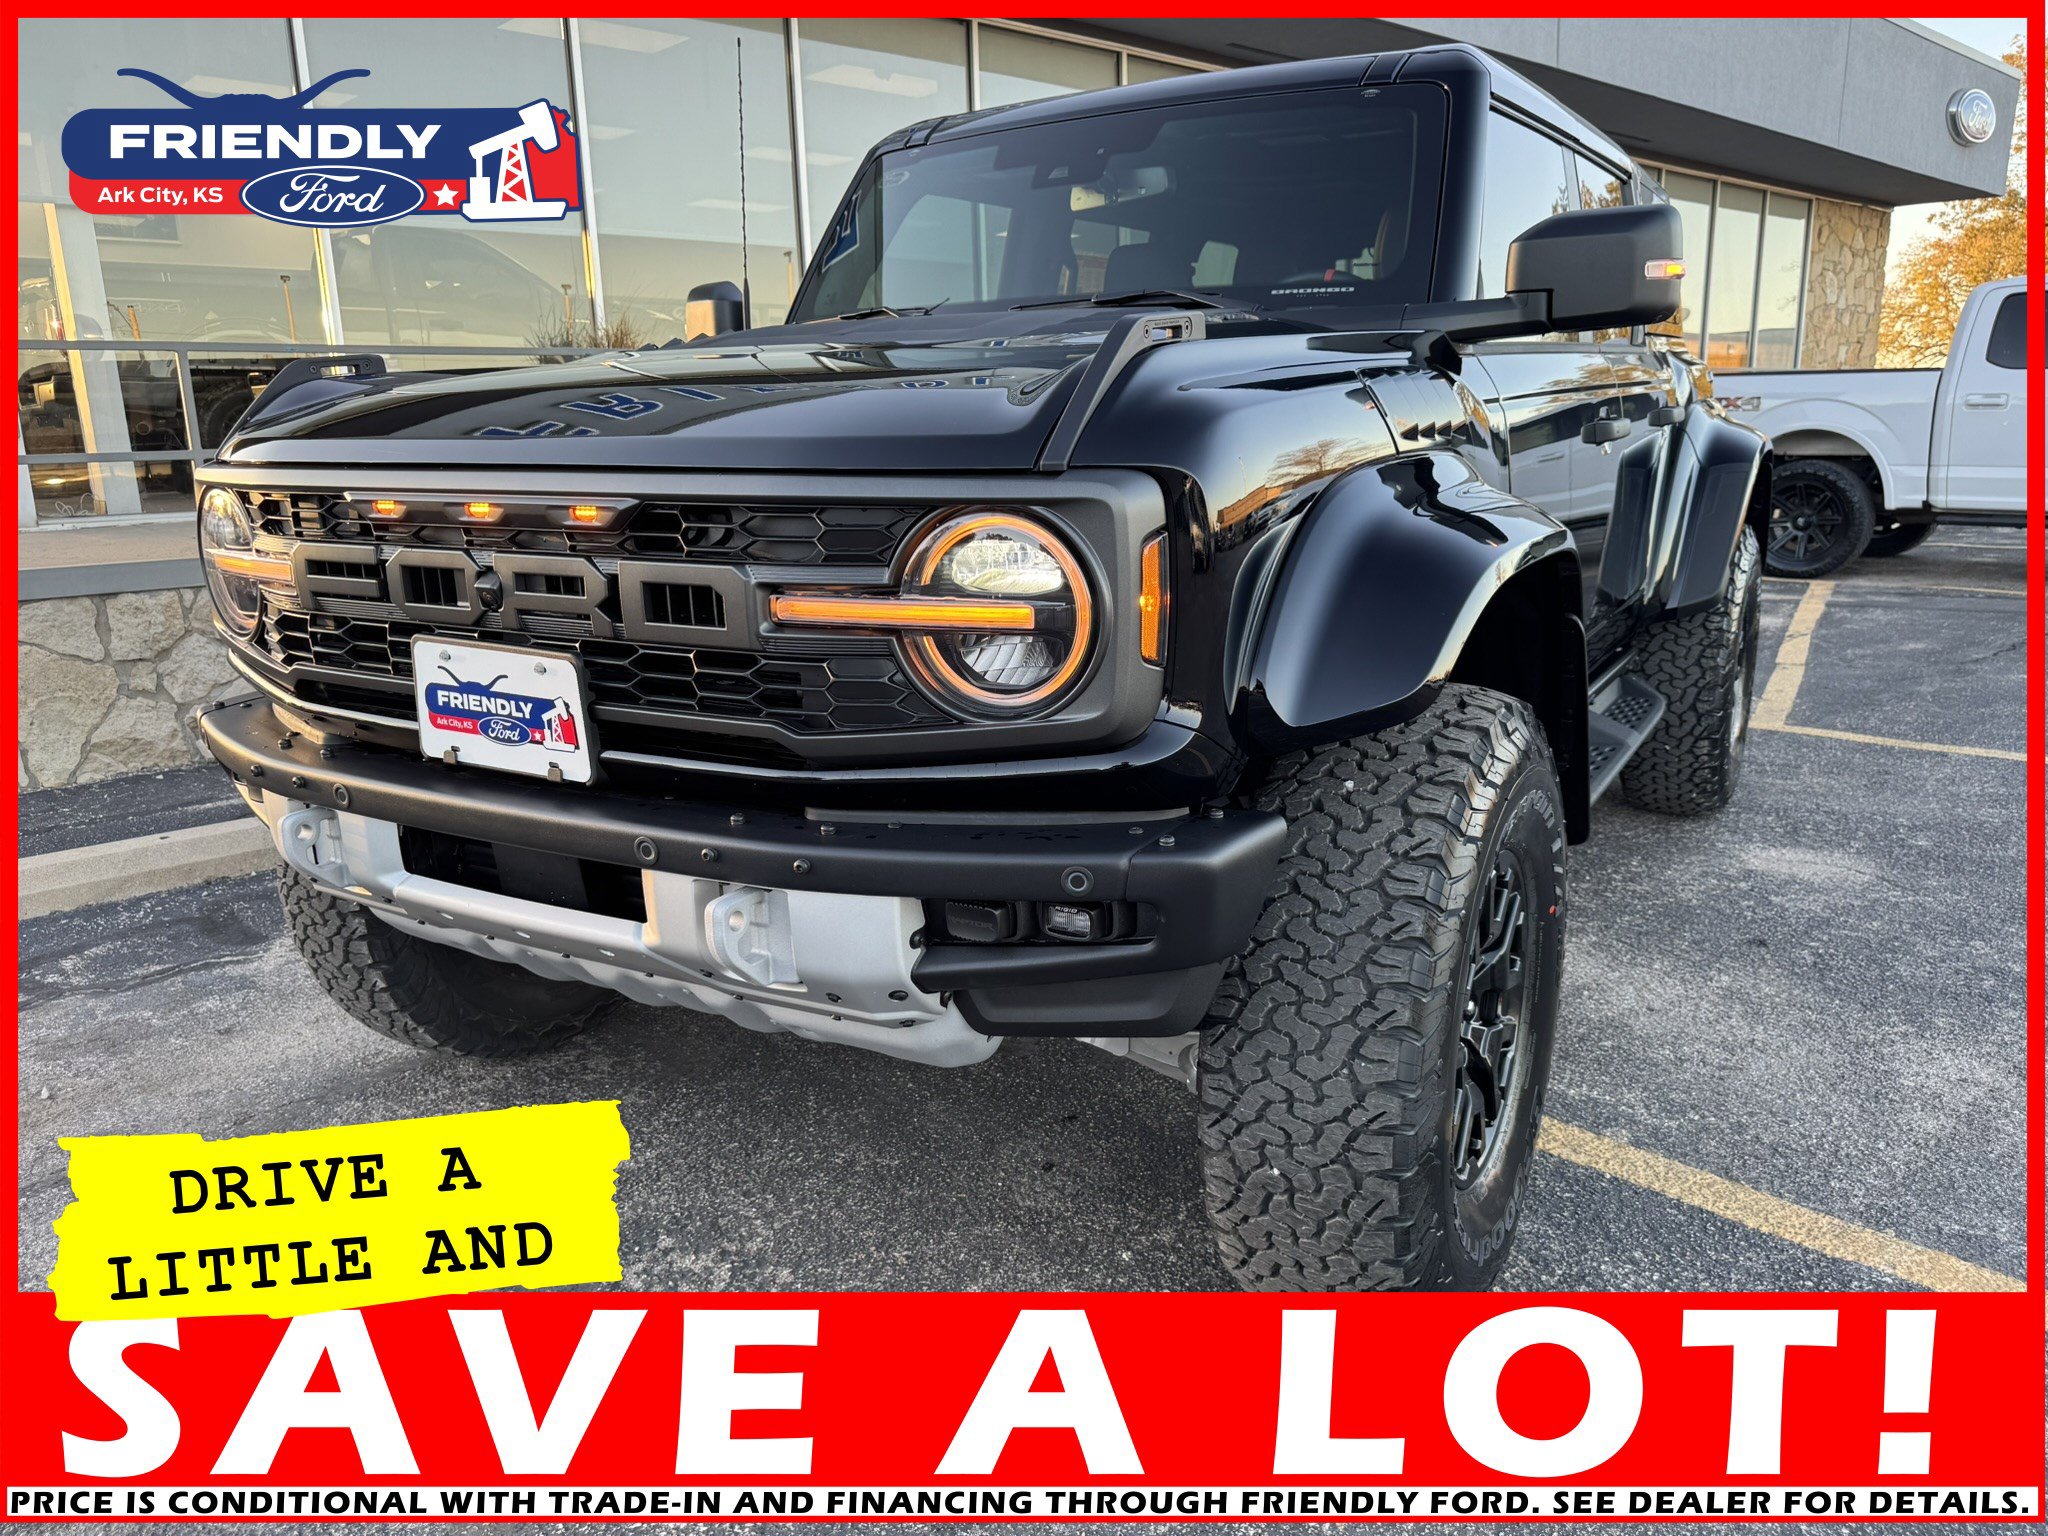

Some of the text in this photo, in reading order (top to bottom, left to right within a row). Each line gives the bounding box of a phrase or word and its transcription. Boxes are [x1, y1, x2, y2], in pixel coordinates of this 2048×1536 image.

[1967, 99, 1993, 131] Ford
[1271, 286, 1355, 294] BRONCO
[291, 541, 754, 652] FORD
[436, 689, 533, 720] FRIENDLY
[436, 716, 474, 730] Ark City, KS
[488, 719, 521, 742] Ford
[1054, 905, 1078, 914] RIGID
